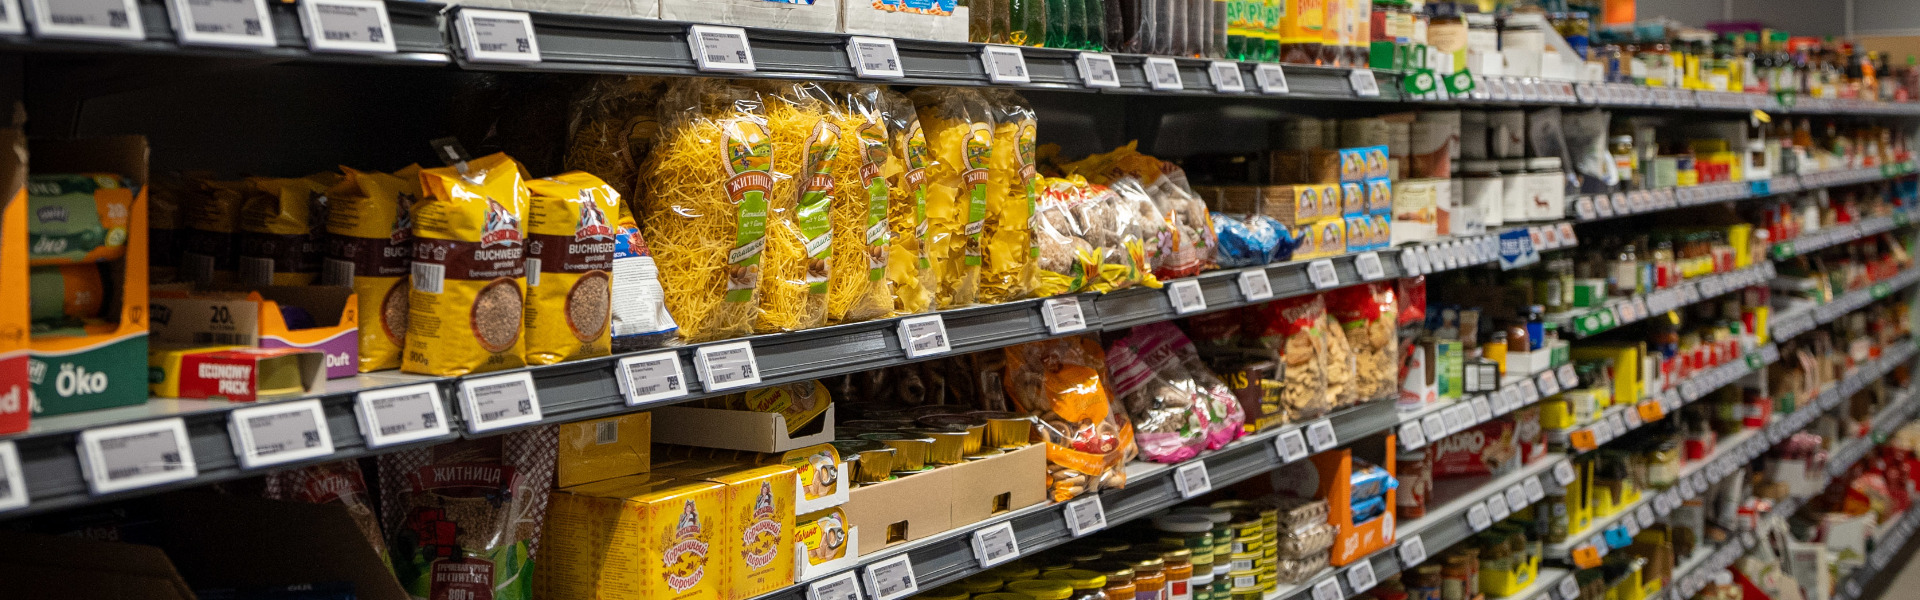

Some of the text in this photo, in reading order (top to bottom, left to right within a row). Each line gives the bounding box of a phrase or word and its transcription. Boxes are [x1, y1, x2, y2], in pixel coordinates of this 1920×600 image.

[731, 174, 771, 193] ЖИТНИЦА
[327, 352, 350, 368] Duft
[56, 362, 108, 398] Öko
[198, 362, 252, 382] ECONOMY
[218, 379, 250, 395] PACK
[434, 466, 501, 483] ЖИТНИЦА
[665, 540, 708, 567] Горчичный
[746, 545, 777, 571] порошок
[669, 566, 704, 594] порошок
